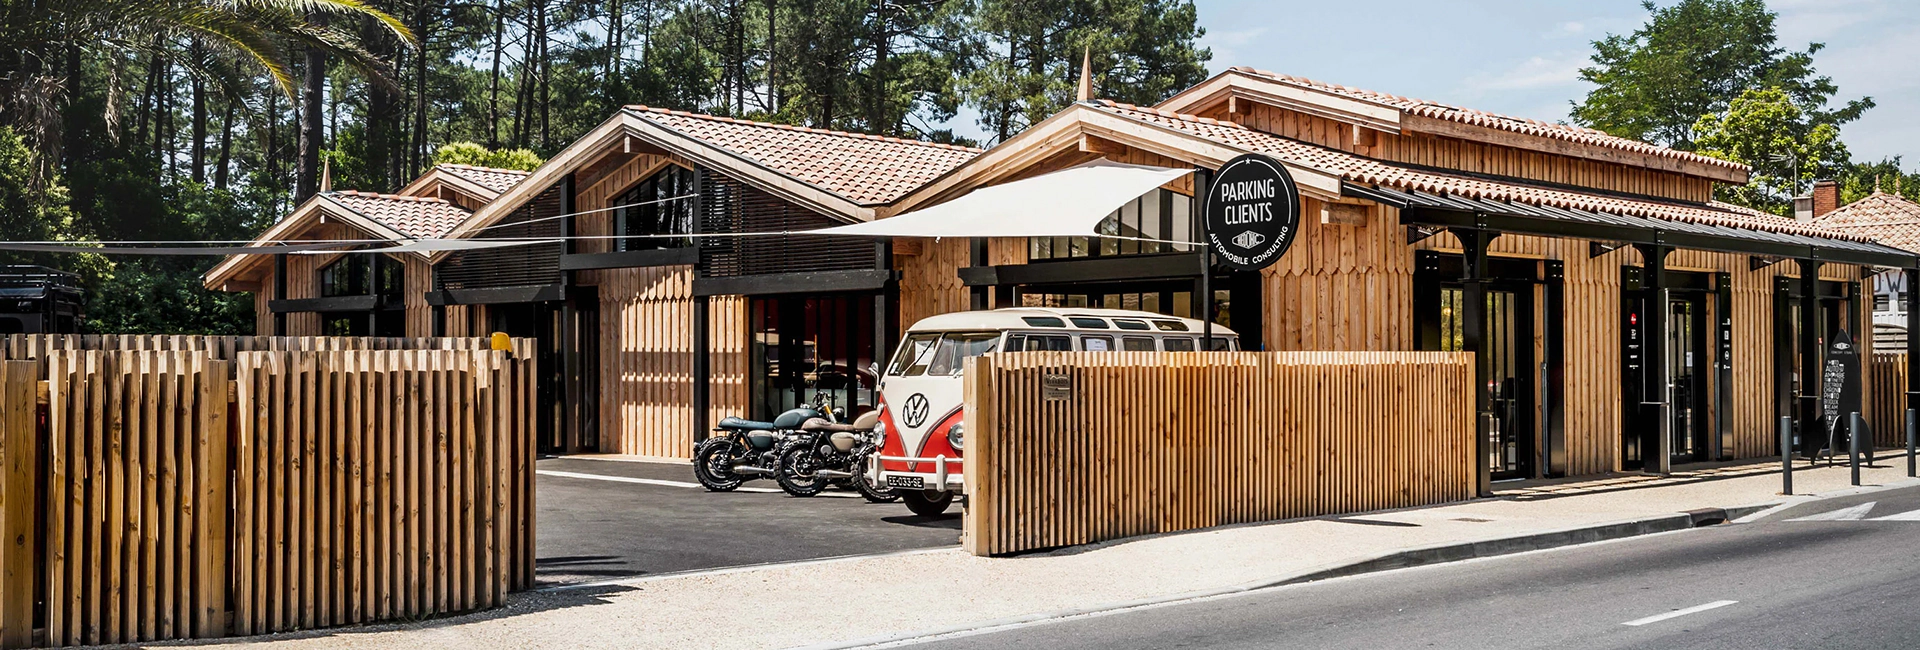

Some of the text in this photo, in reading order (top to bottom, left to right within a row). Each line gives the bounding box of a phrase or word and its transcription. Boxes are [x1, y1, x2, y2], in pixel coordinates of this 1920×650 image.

[1221, 178, 1275, 202] PARKING
[1224, 202, 1273, 225] CLIENTS
[1210, 225, 1288, 265] AUTOMOBILE CONSULTING
[888, 476, 923, 487] EE-033-SE
